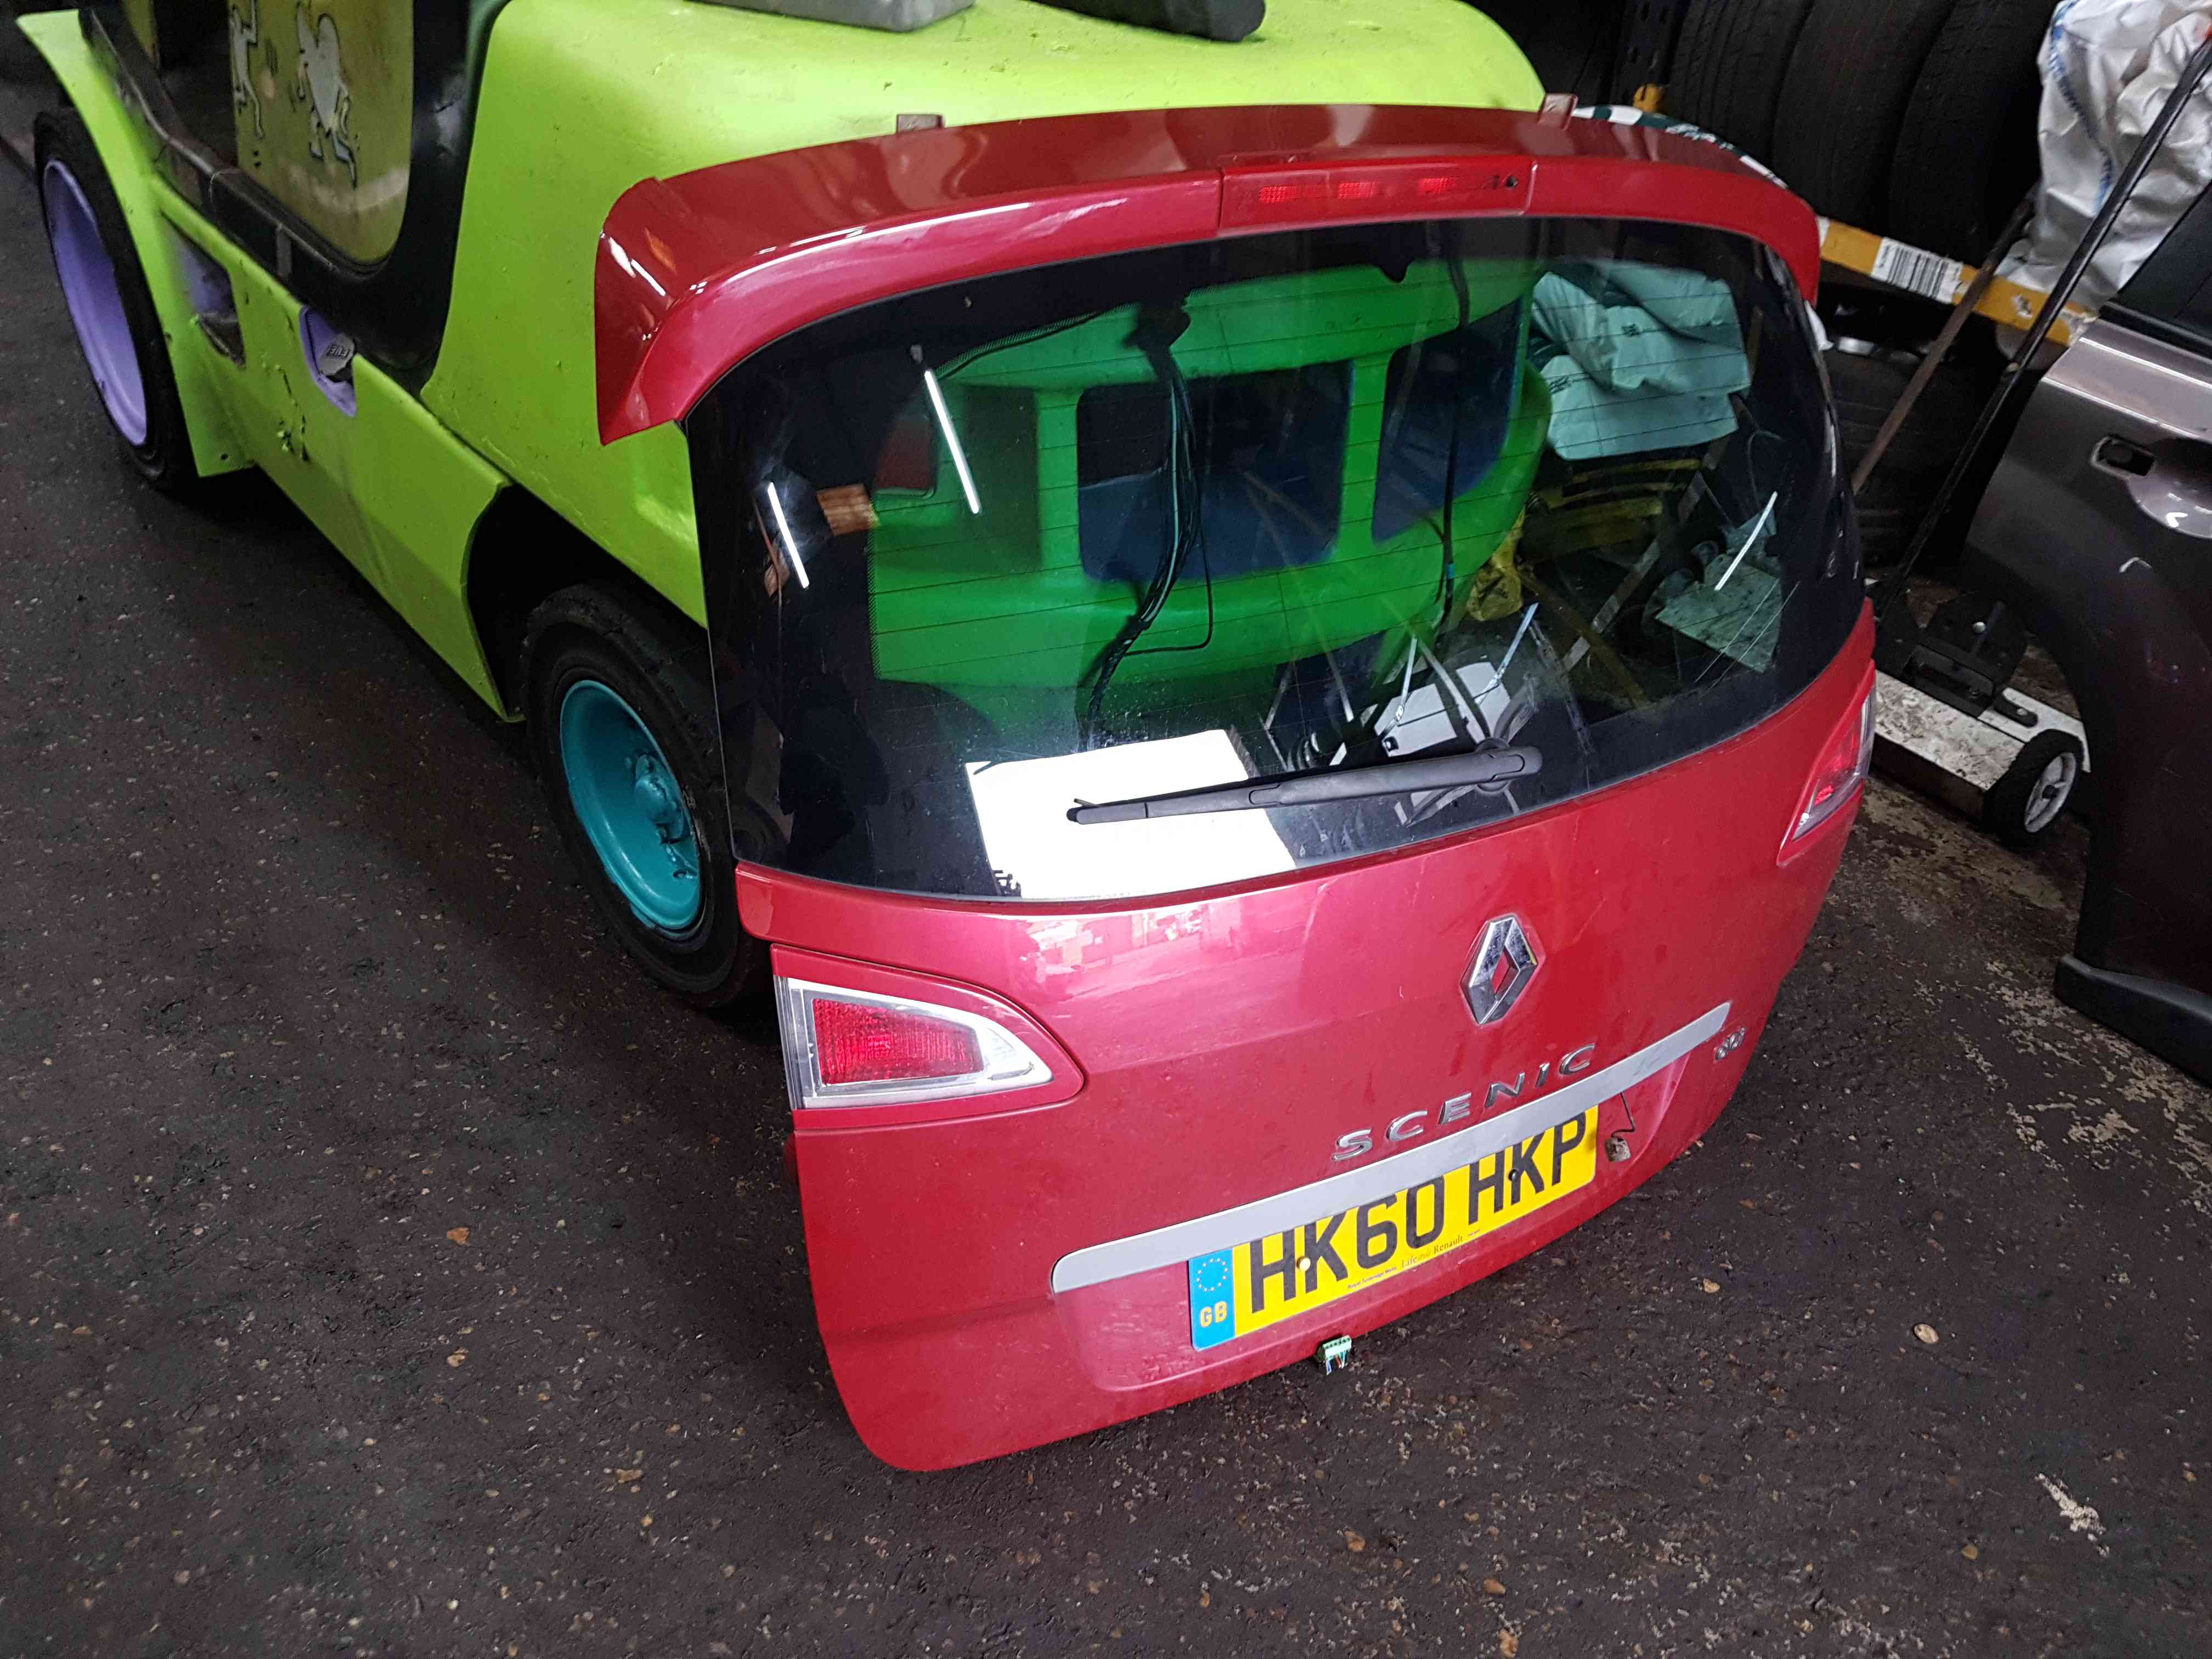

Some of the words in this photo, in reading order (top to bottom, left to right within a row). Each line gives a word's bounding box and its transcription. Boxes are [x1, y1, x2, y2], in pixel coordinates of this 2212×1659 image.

[1331, 1043, 1595, 1161] SCENIC
[1250, 1175, 1444, 1314] HK60
[1468, 1111, 1586, 1226] HKP
[1434, 1234, 1464, 1254] Renault
[1200, 1301, 1228, 1328] GB
